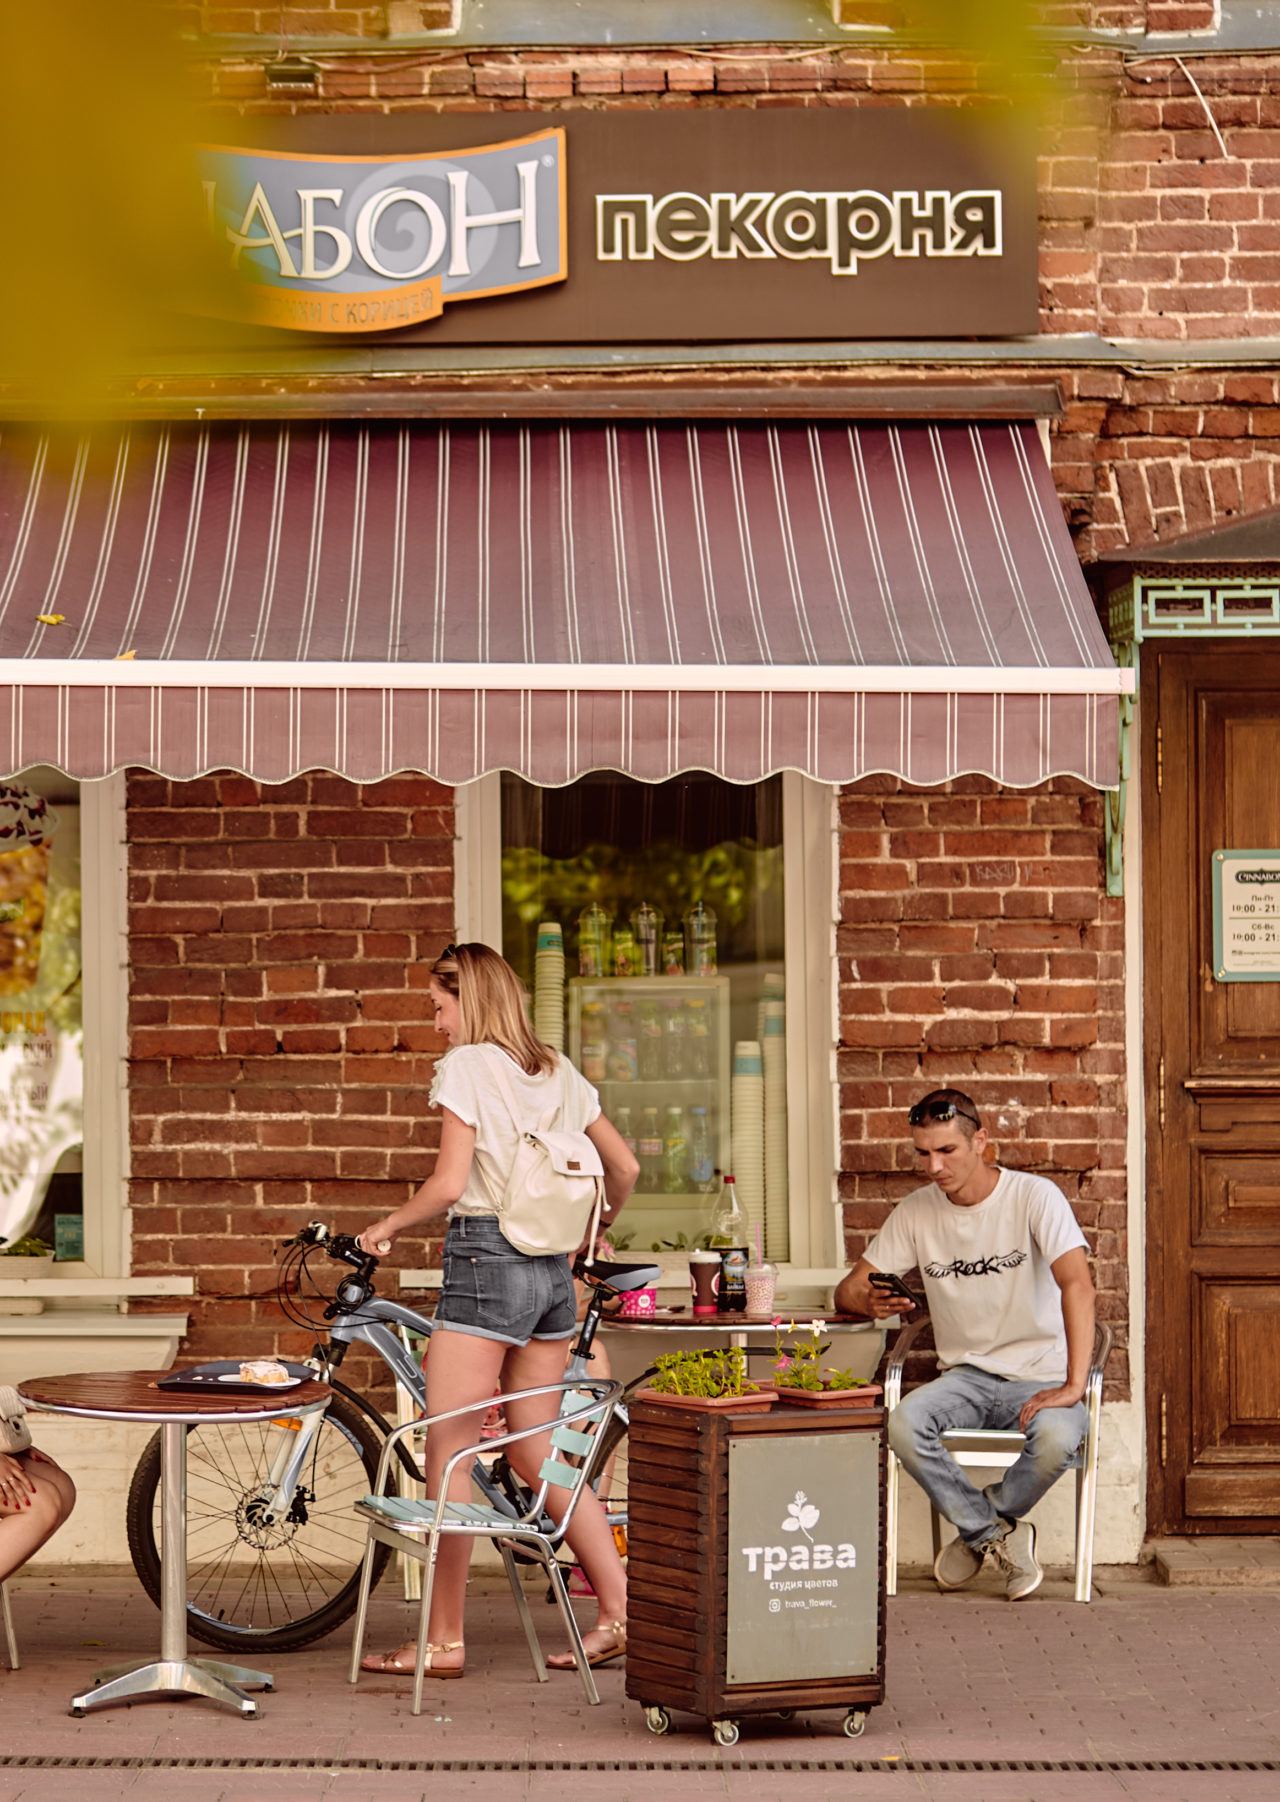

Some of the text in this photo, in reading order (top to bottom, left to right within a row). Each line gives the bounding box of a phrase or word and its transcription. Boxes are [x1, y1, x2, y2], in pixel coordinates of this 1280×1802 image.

[595, 190, 1002, 276] пекарня
[346, 288, 433, 325] КОРИЦЕЙ
[741, 1543, 857, 1581] трава
[769, 1580, 839, 1591] студия цветов
